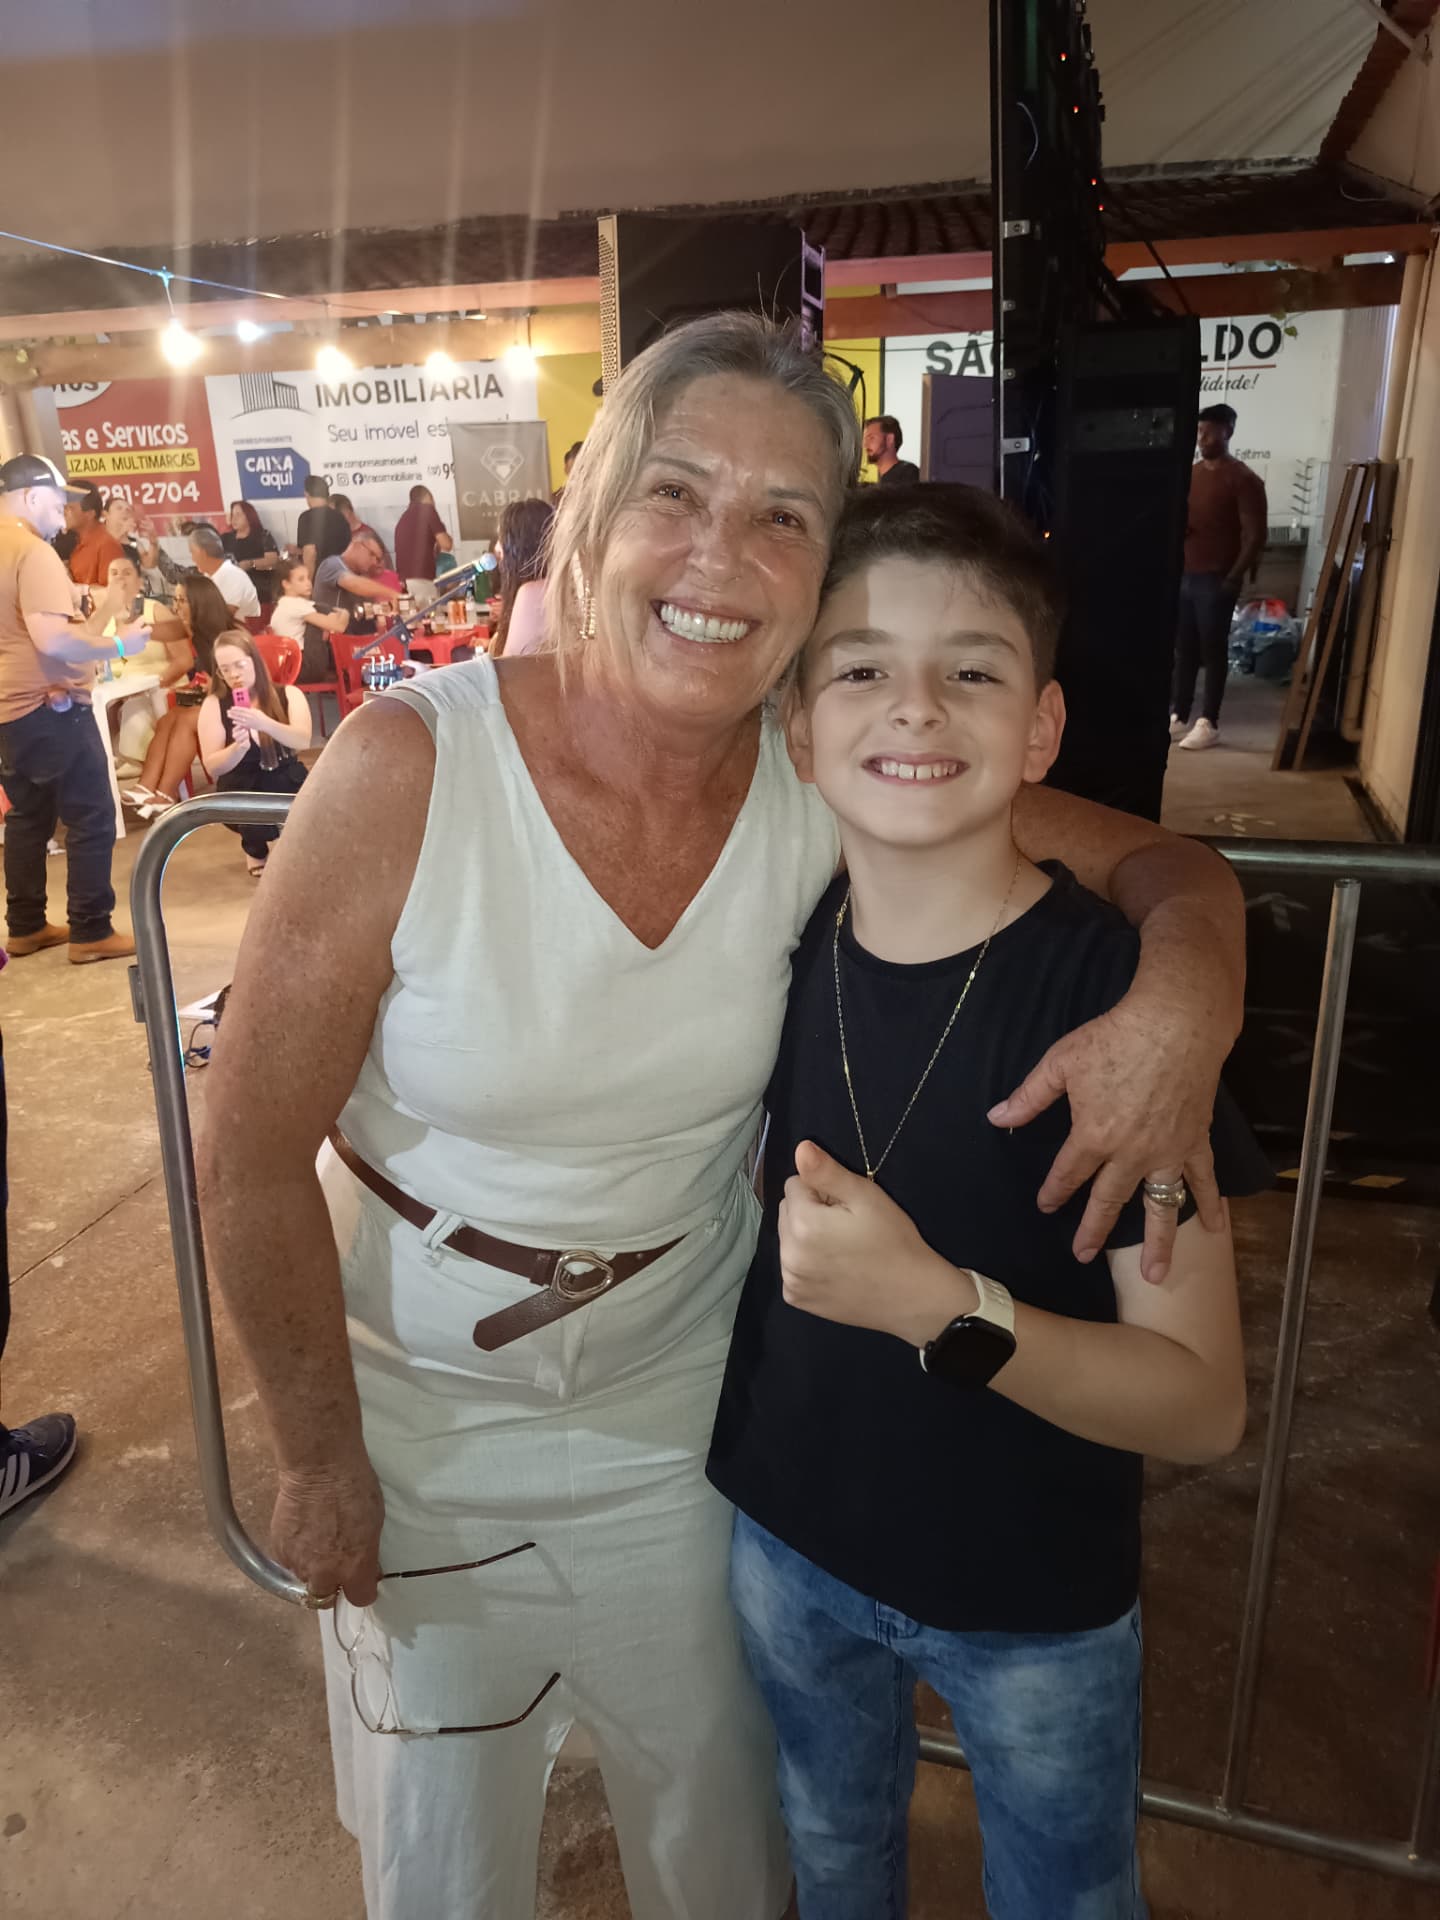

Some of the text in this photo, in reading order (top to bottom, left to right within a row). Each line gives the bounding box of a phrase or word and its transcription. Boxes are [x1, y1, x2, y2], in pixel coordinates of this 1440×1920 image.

[1200, 322, 1282, 362] DO
[926, 331, 994, 375] SÃ
[85, 428, 99, 449] e
[328, 416, 449, 443] Seu imóvel es
[69, 452, 196, 473] IZADA MULTIMARCAS
[245, 455, 294, 472] CAIXA
[260, 471, 293, 491] aqui
